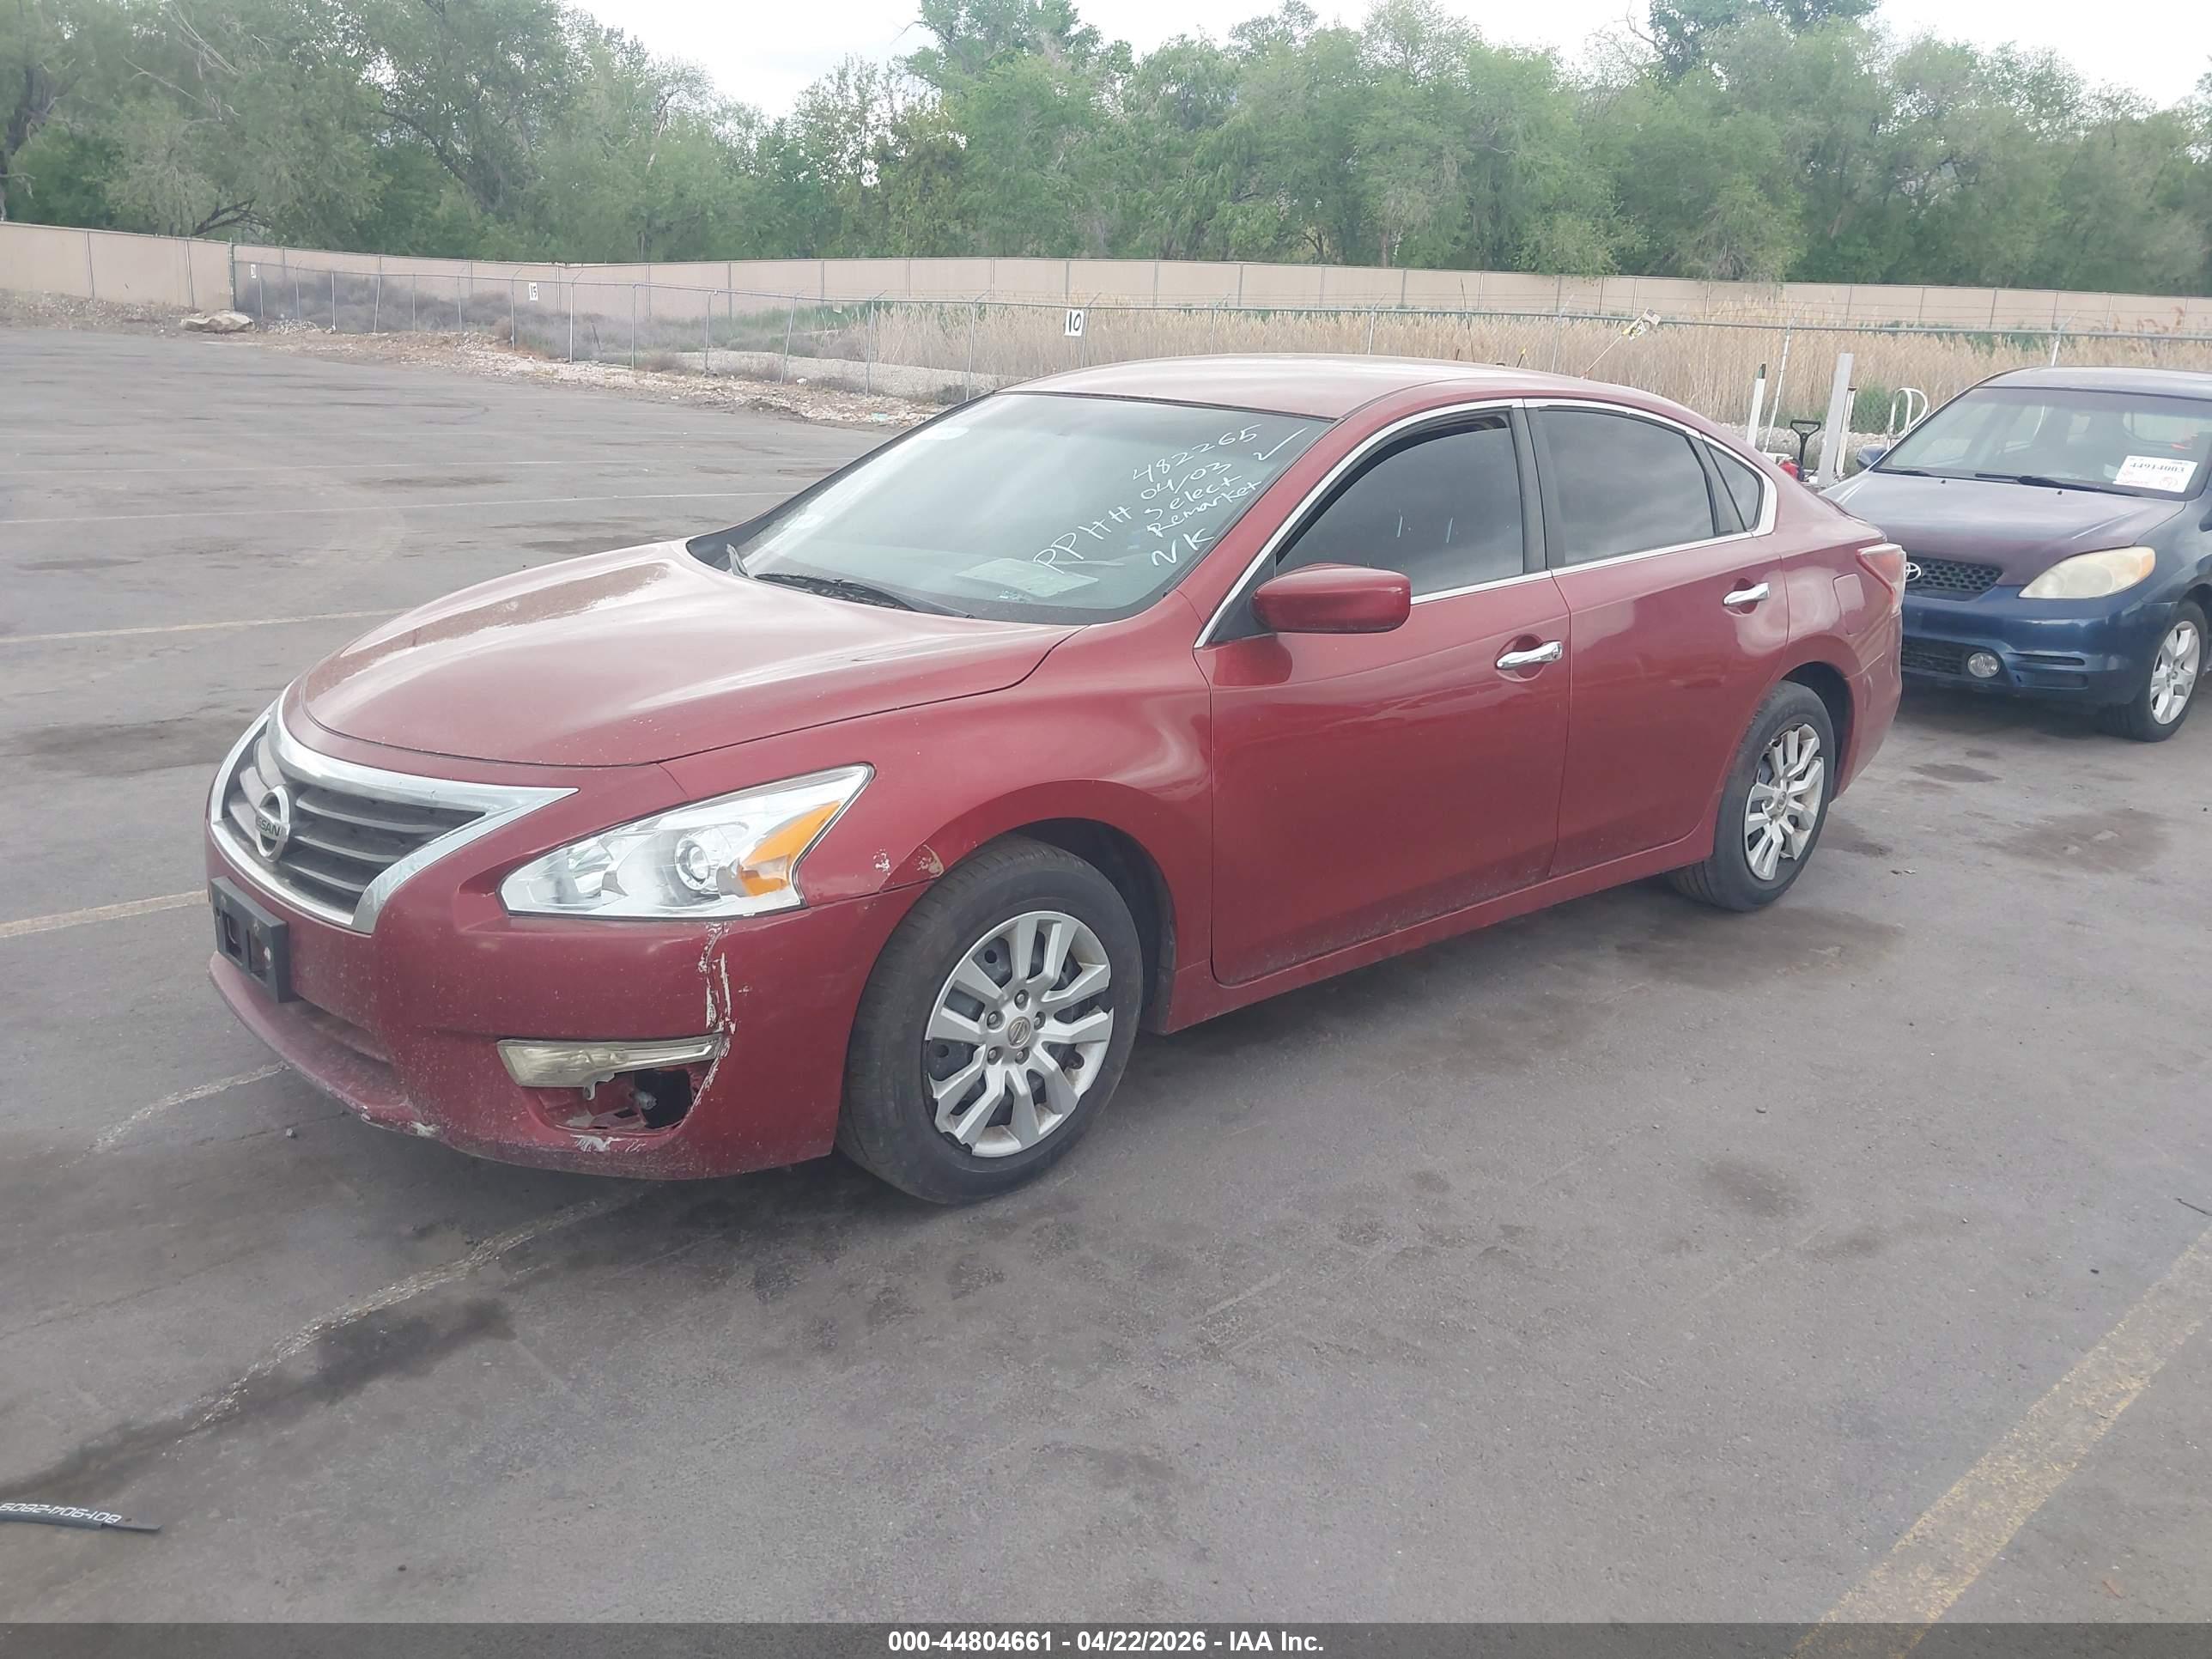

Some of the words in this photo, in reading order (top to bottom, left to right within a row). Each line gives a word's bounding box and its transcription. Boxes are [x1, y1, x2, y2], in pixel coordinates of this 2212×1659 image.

[1068, 311, 1082, 333] 10
[1133, 424, 1262, 483] 482265
[1140, 461, 1233, 501] 04/03
[1146, 480, 1263, 538] Remarket
